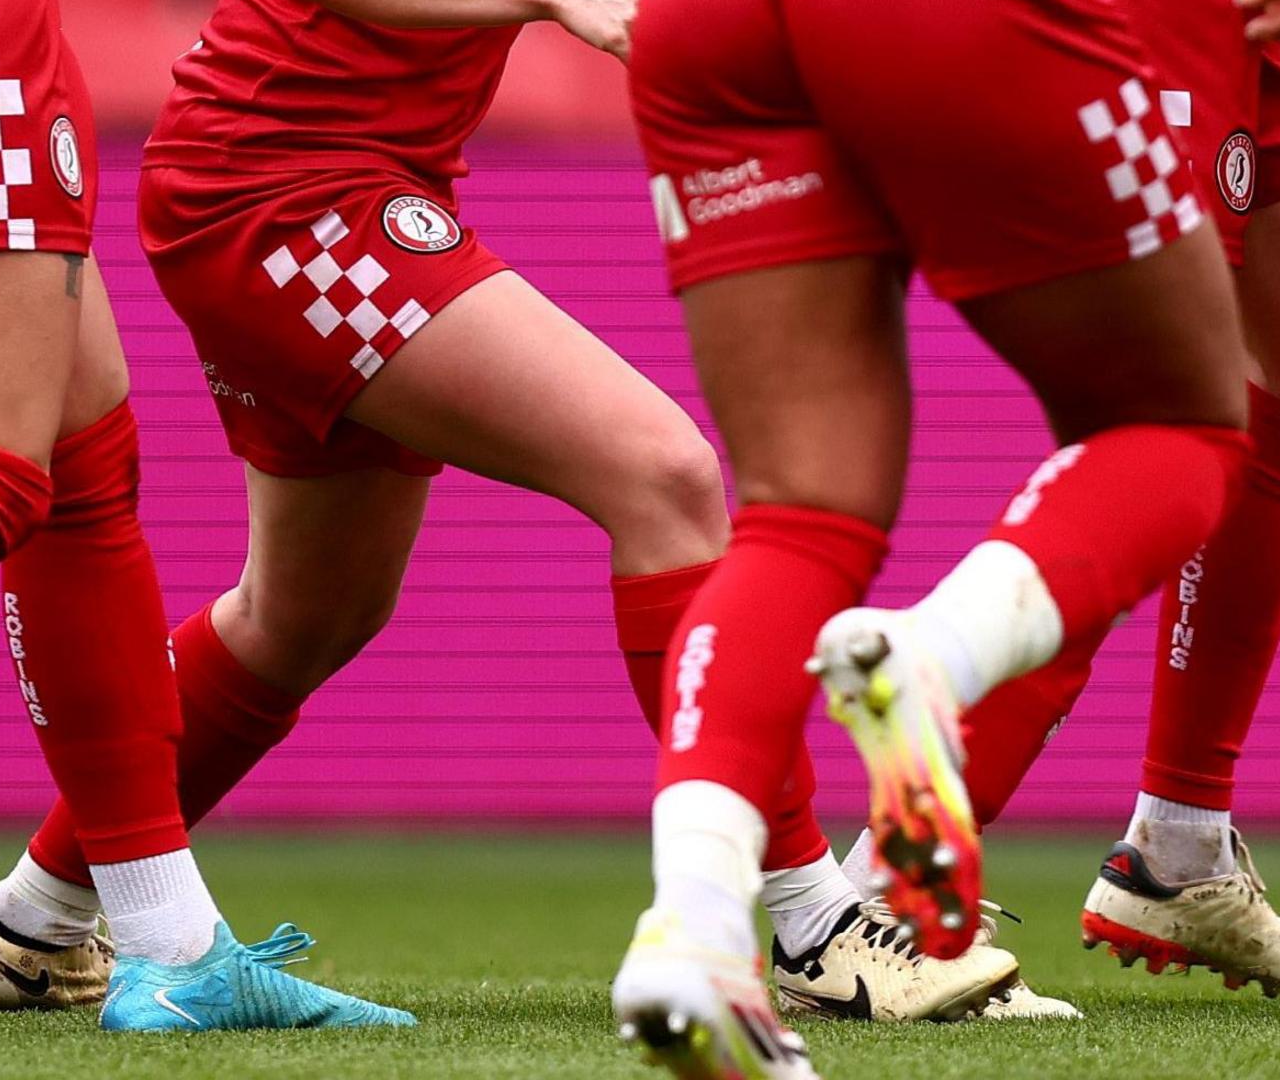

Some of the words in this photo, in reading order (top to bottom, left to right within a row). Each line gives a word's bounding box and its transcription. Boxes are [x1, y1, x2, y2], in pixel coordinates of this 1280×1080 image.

[387, 199, 429, 220] BRISTOL
[687, 171, 824, 225] Goodman
[427, 234, 454, 249] CITY
[3, 591, 49, 726] ROBINS
